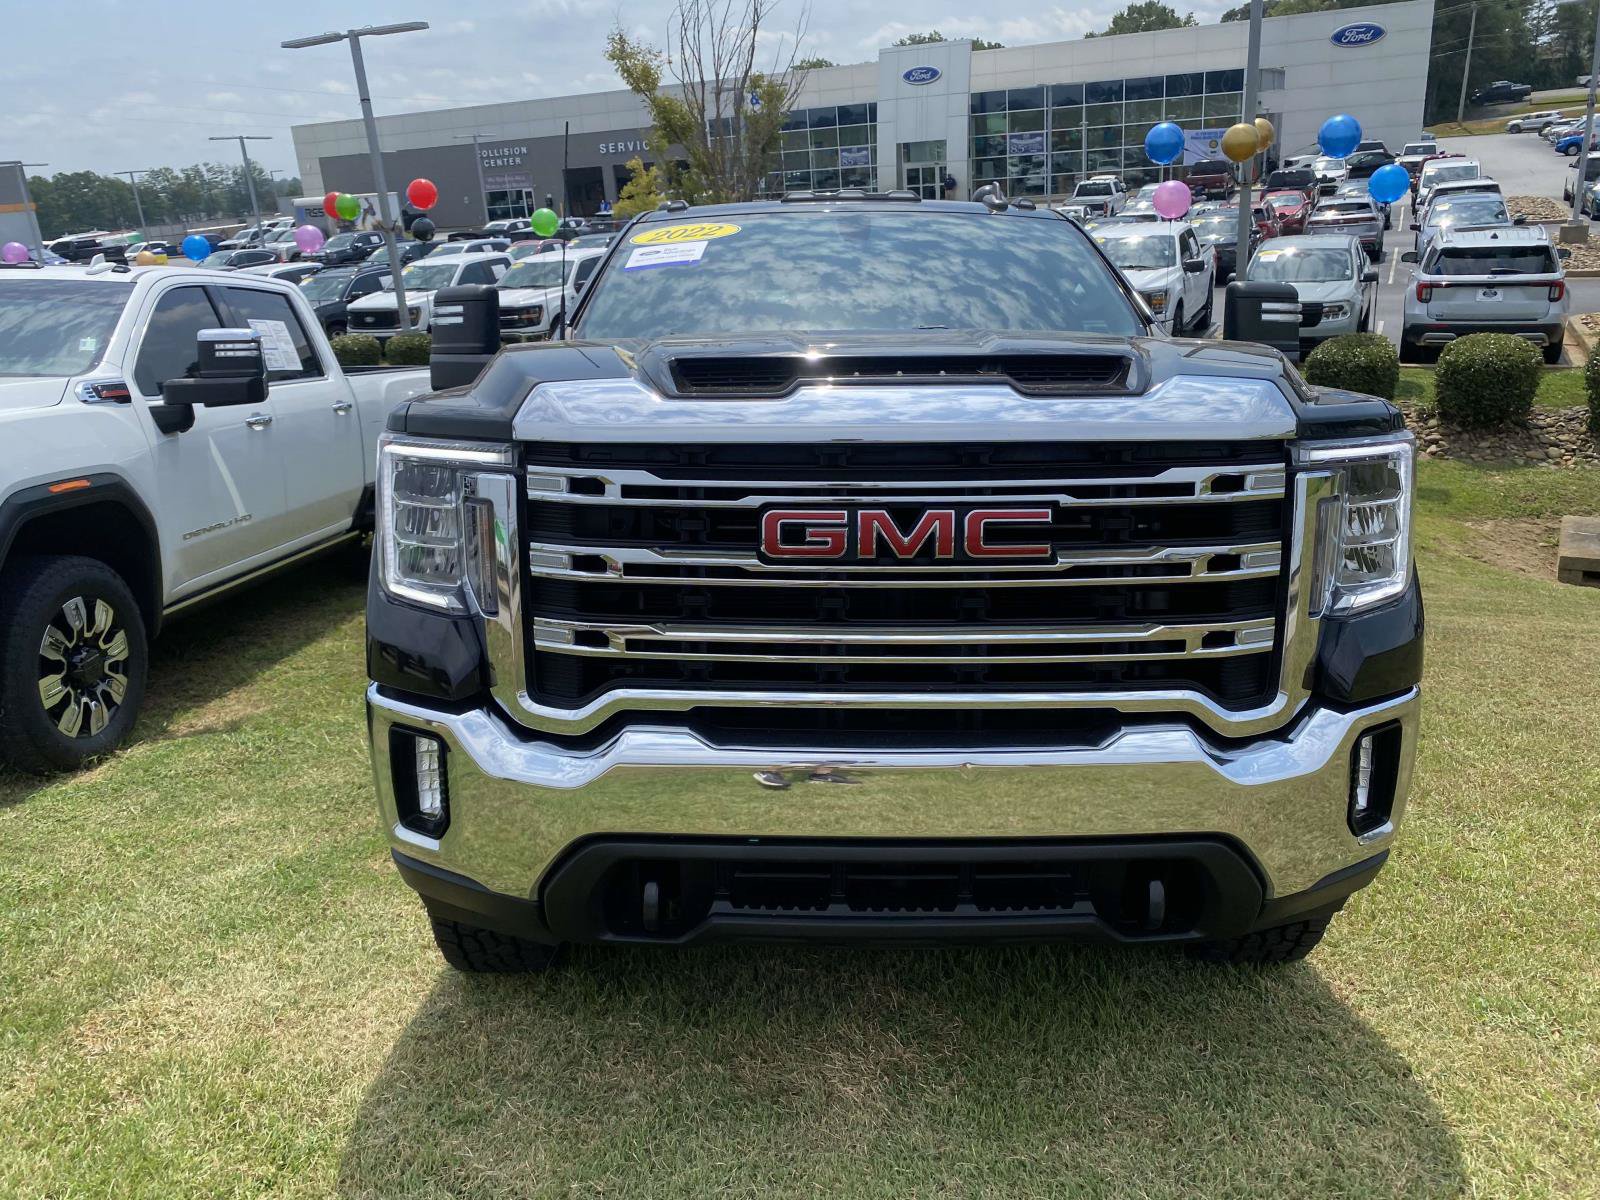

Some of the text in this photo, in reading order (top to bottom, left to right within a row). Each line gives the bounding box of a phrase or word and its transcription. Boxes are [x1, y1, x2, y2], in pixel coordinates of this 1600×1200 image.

[1341, 27, 1375, 43] Ford
[909, 69, 932, 81] Ford
[483, 157, 521, 167] CENTER
[646, 225, 724, 243] 2022
[761, 508, 1053, 559] GMC
